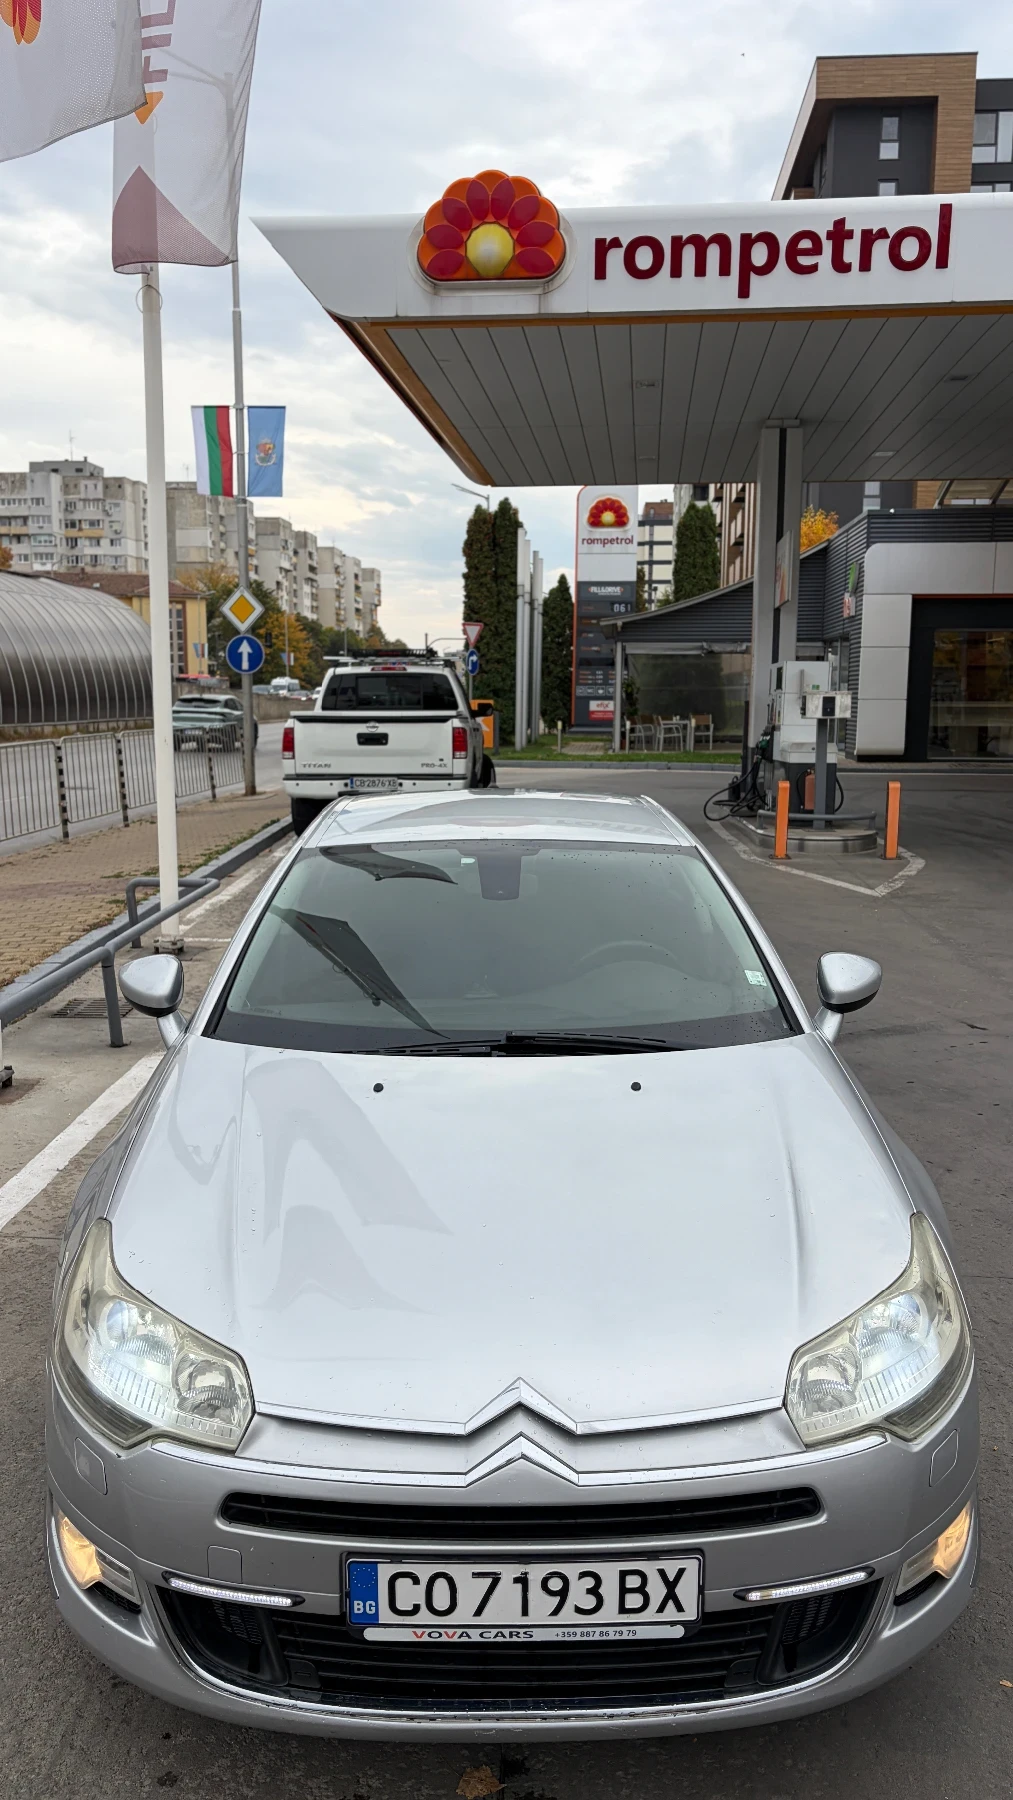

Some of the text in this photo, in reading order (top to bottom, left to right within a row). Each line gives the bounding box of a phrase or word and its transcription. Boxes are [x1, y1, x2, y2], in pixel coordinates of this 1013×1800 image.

[594, 203, 952, 299] rompetrol
[581, 534, 634, 548] rompetrol
[353, 1600, 376, 1615] BG
[412, 1630, 473, 1640] VOVA
[478, 1630, 534, 1640] CARS
[554, 1630, 578, 1639] +359
[579, 1630, 597, 1638] 887
[612, 1629, 624, 1637] 79
